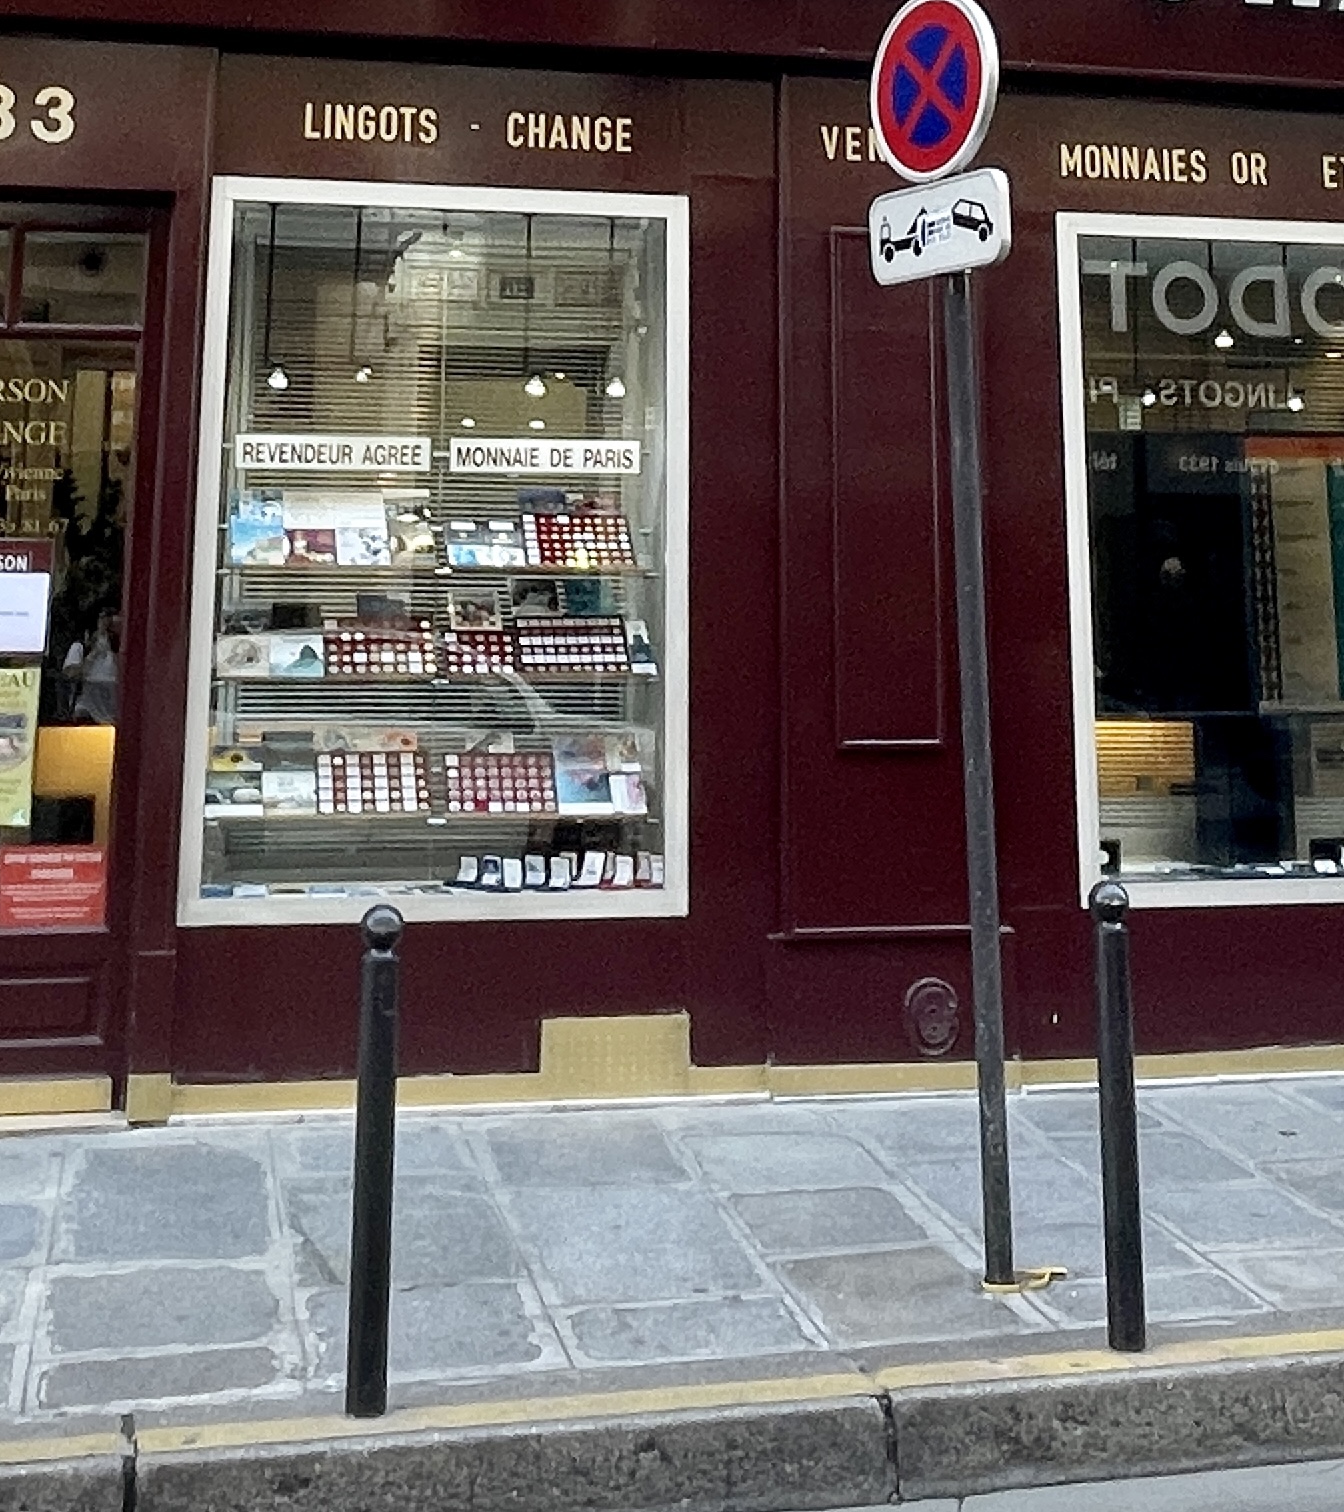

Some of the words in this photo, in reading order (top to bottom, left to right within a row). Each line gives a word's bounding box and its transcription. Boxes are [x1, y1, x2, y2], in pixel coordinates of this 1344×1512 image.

[304, 100, 440, 145] LINGOTS
[505, 111, 634, 153] CHANGE
[820, 125, 887, 162] VEN
[1059, 143, 1209, 184] MONNAIES
[1230, 151, 1269, 187] OR
[242, 441, 354, 465] REVENDEUR
[362, 444, 423, 467] AGREE
[456, 446, 541, 468] MONNAIE
[550, 448, 573, 469] DE
[582, 448, 635, 471] PARIS
